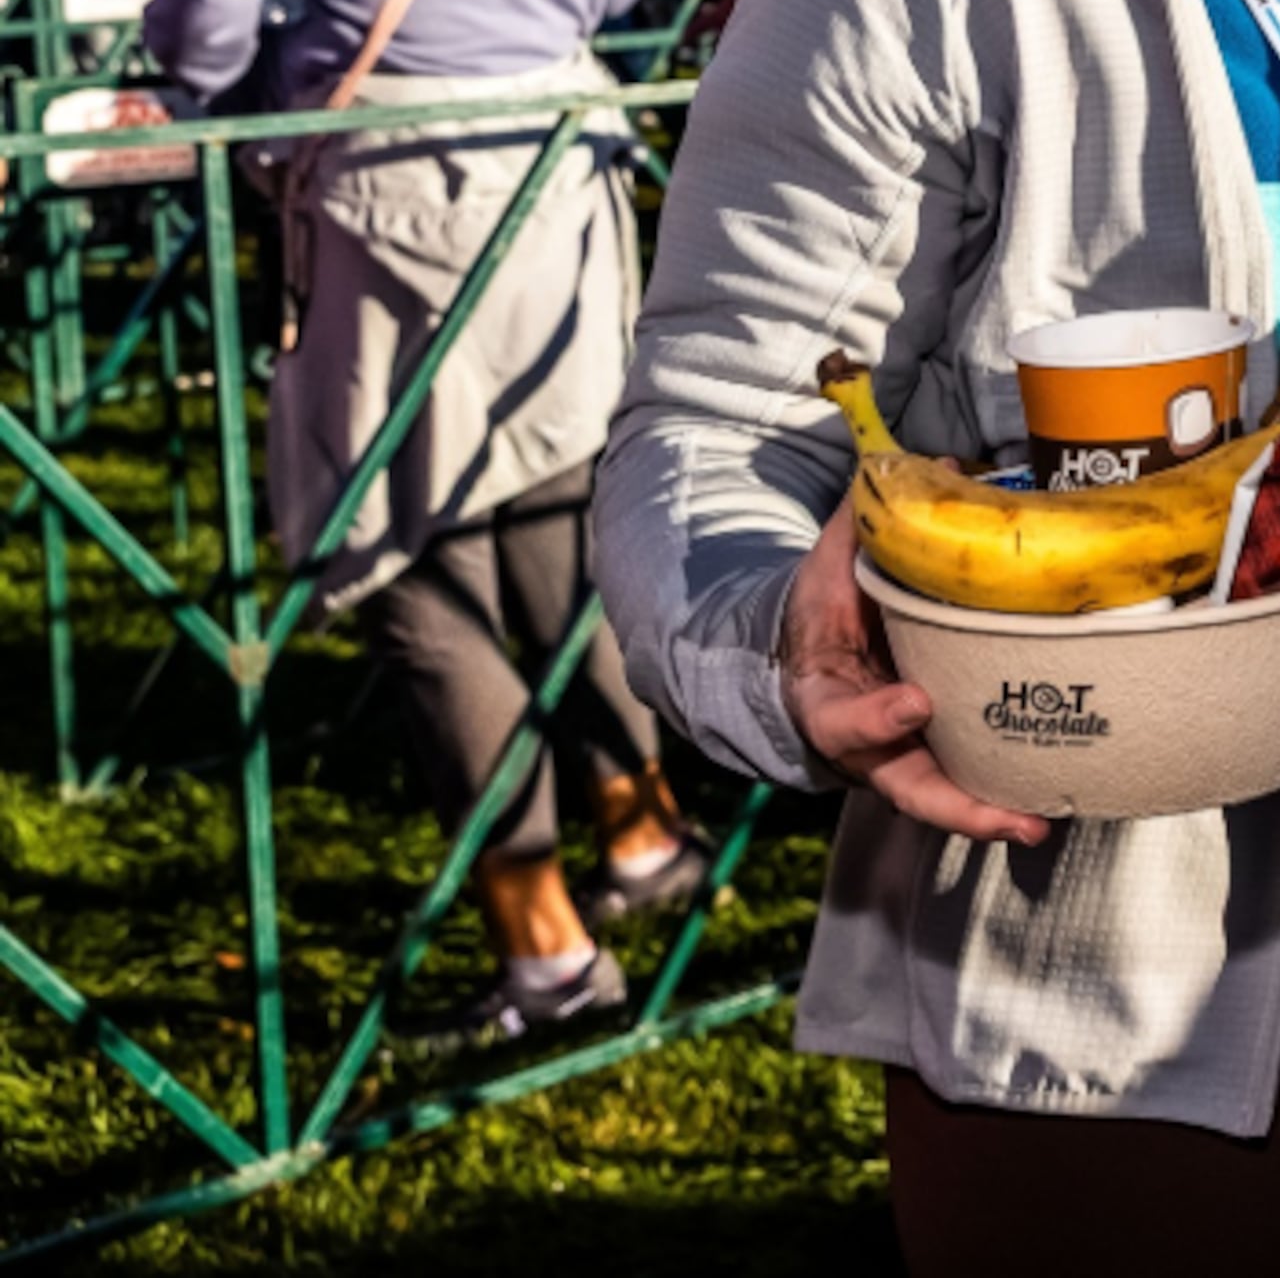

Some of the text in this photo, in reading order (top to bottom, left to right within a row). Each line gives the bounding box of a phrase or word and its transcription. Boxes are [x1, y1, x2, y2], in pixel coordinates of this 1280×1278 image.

[1062, 448, 1150, 484] HOT
[1003, 681, 1094, 714] HOT
[984, 702, 1112, 736] Chocolate
